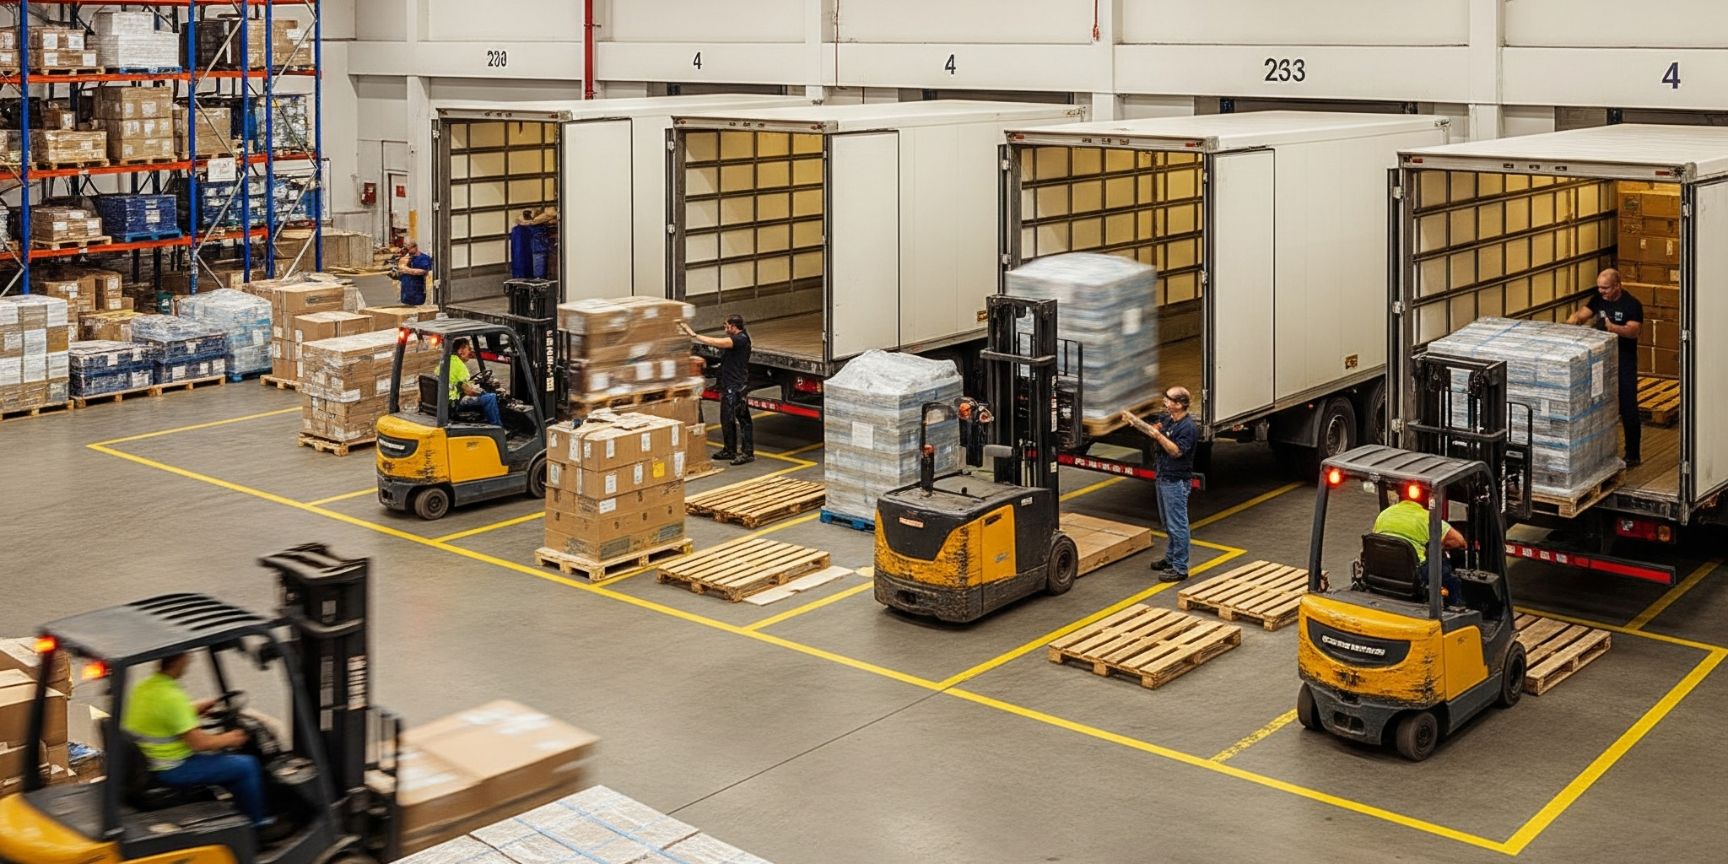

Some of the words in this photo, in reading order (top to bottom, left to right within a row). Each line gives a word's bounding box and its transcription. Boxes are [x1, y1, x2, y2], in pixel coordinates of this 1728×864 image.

[693, 51, 703, 70] 4
[944, 54, 957, 75] 4
[1661, 62, 1681, 90] 4
